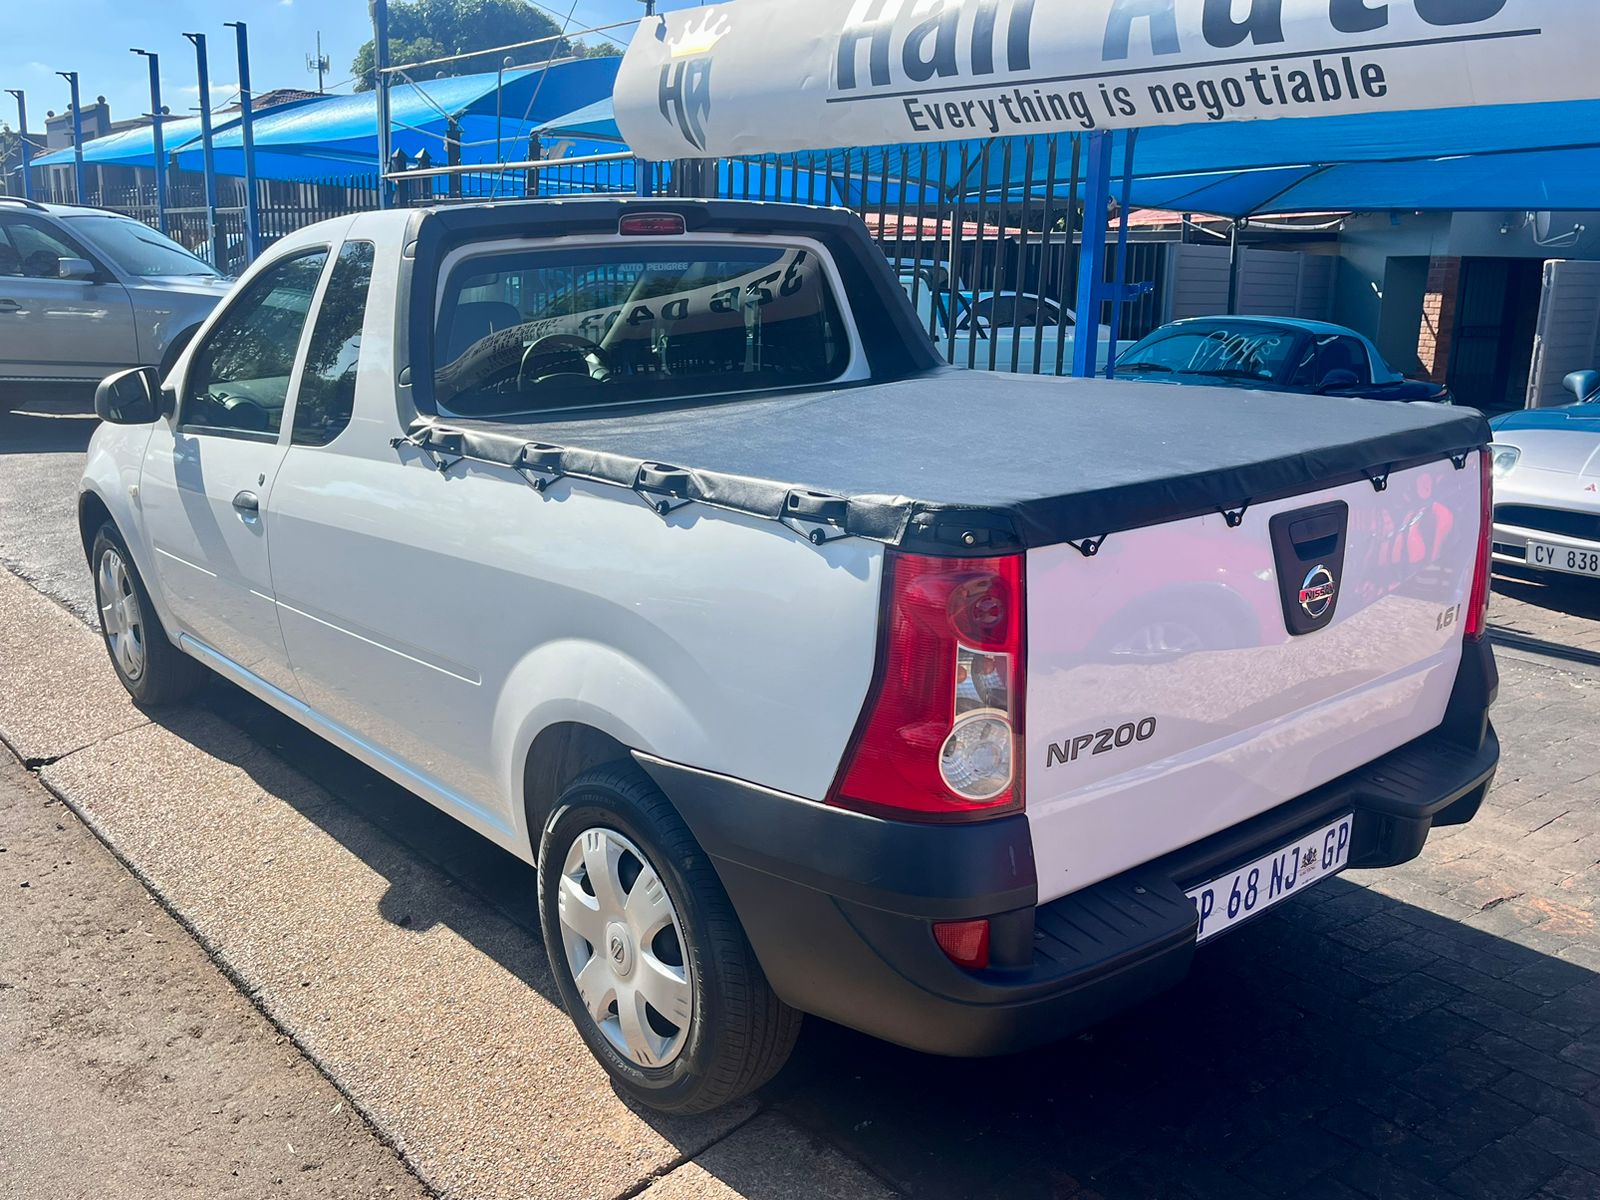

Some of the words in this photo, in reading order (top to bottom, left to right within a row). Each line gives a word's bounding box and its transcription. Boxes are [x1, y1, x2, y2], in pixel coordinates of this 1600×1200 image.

[902, 88, 1096, 133] Everything
[1098, 83, 1137, 117] is
[1148, 56, 1388, 121] negotiable
[620, 263, 644, 271] AUTO
[646, 262, 689, 271] PEDIGREE
[1535, 546, 1555, 565] CY
[1567, 550, 1599, 572] 838
[1046, 716, 1157, 768] NP200
[1227, 867, 1260, 920] 68
[1268, 846, 1301, 900] NJ
[1321, 821, 1350, 870] GP
